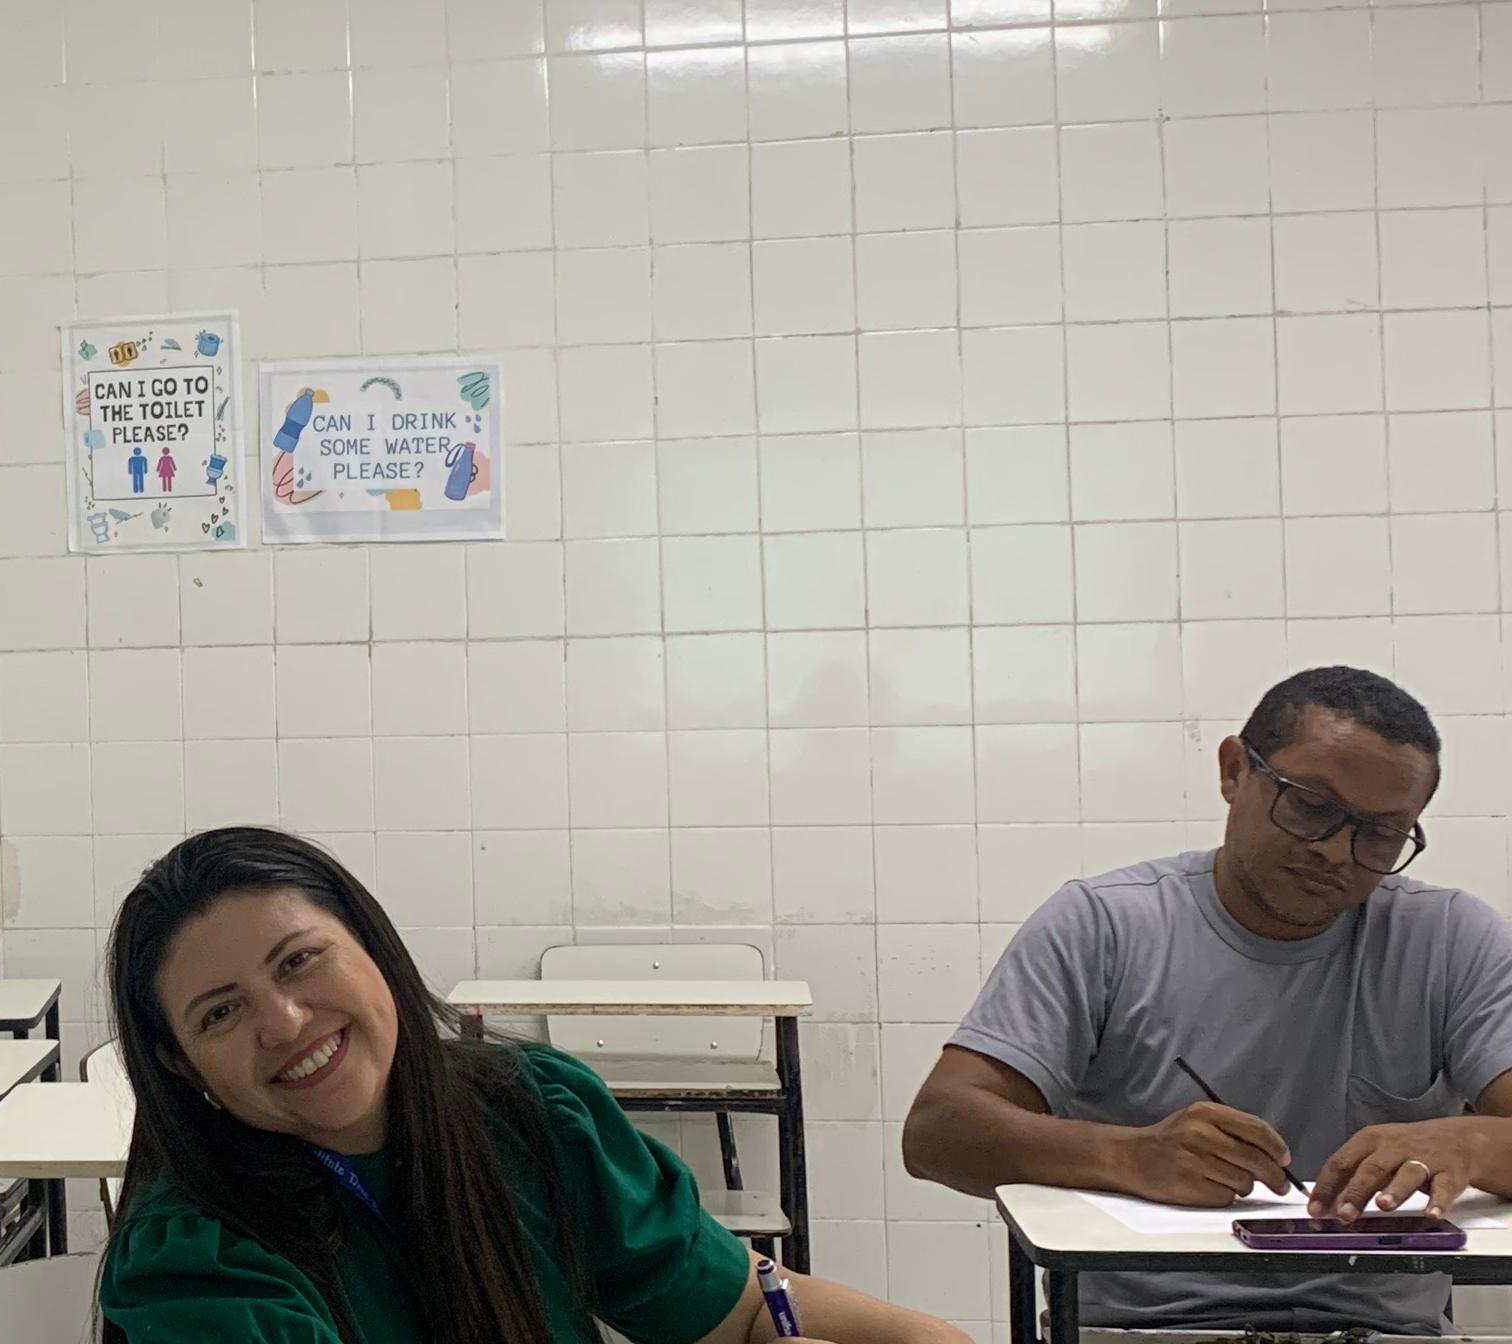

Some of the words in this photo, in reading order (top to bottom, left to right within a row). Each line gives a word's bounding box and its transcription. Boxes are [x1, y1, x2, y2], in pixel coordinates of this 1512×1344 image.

[95, 381, 132, 400] CAN
[137, 380, 146, 398] I
[151, 377, 178, 397] GO
[183, 375, 209, 395] TO
[100, 404, 134, 423] THE
[139, 400, 206, 420] TOILET
[312, 414, 351, 433] CAN
[367, 414, 376, 431] I
[392, 412, 457, 431] DRINK
[112, 423, 190, 445] PLEASE?
[320, 438, 371, 457] SOME
[384, 436, 451, 455] WATER
[333, 461, 425, 480] PLEASE?
